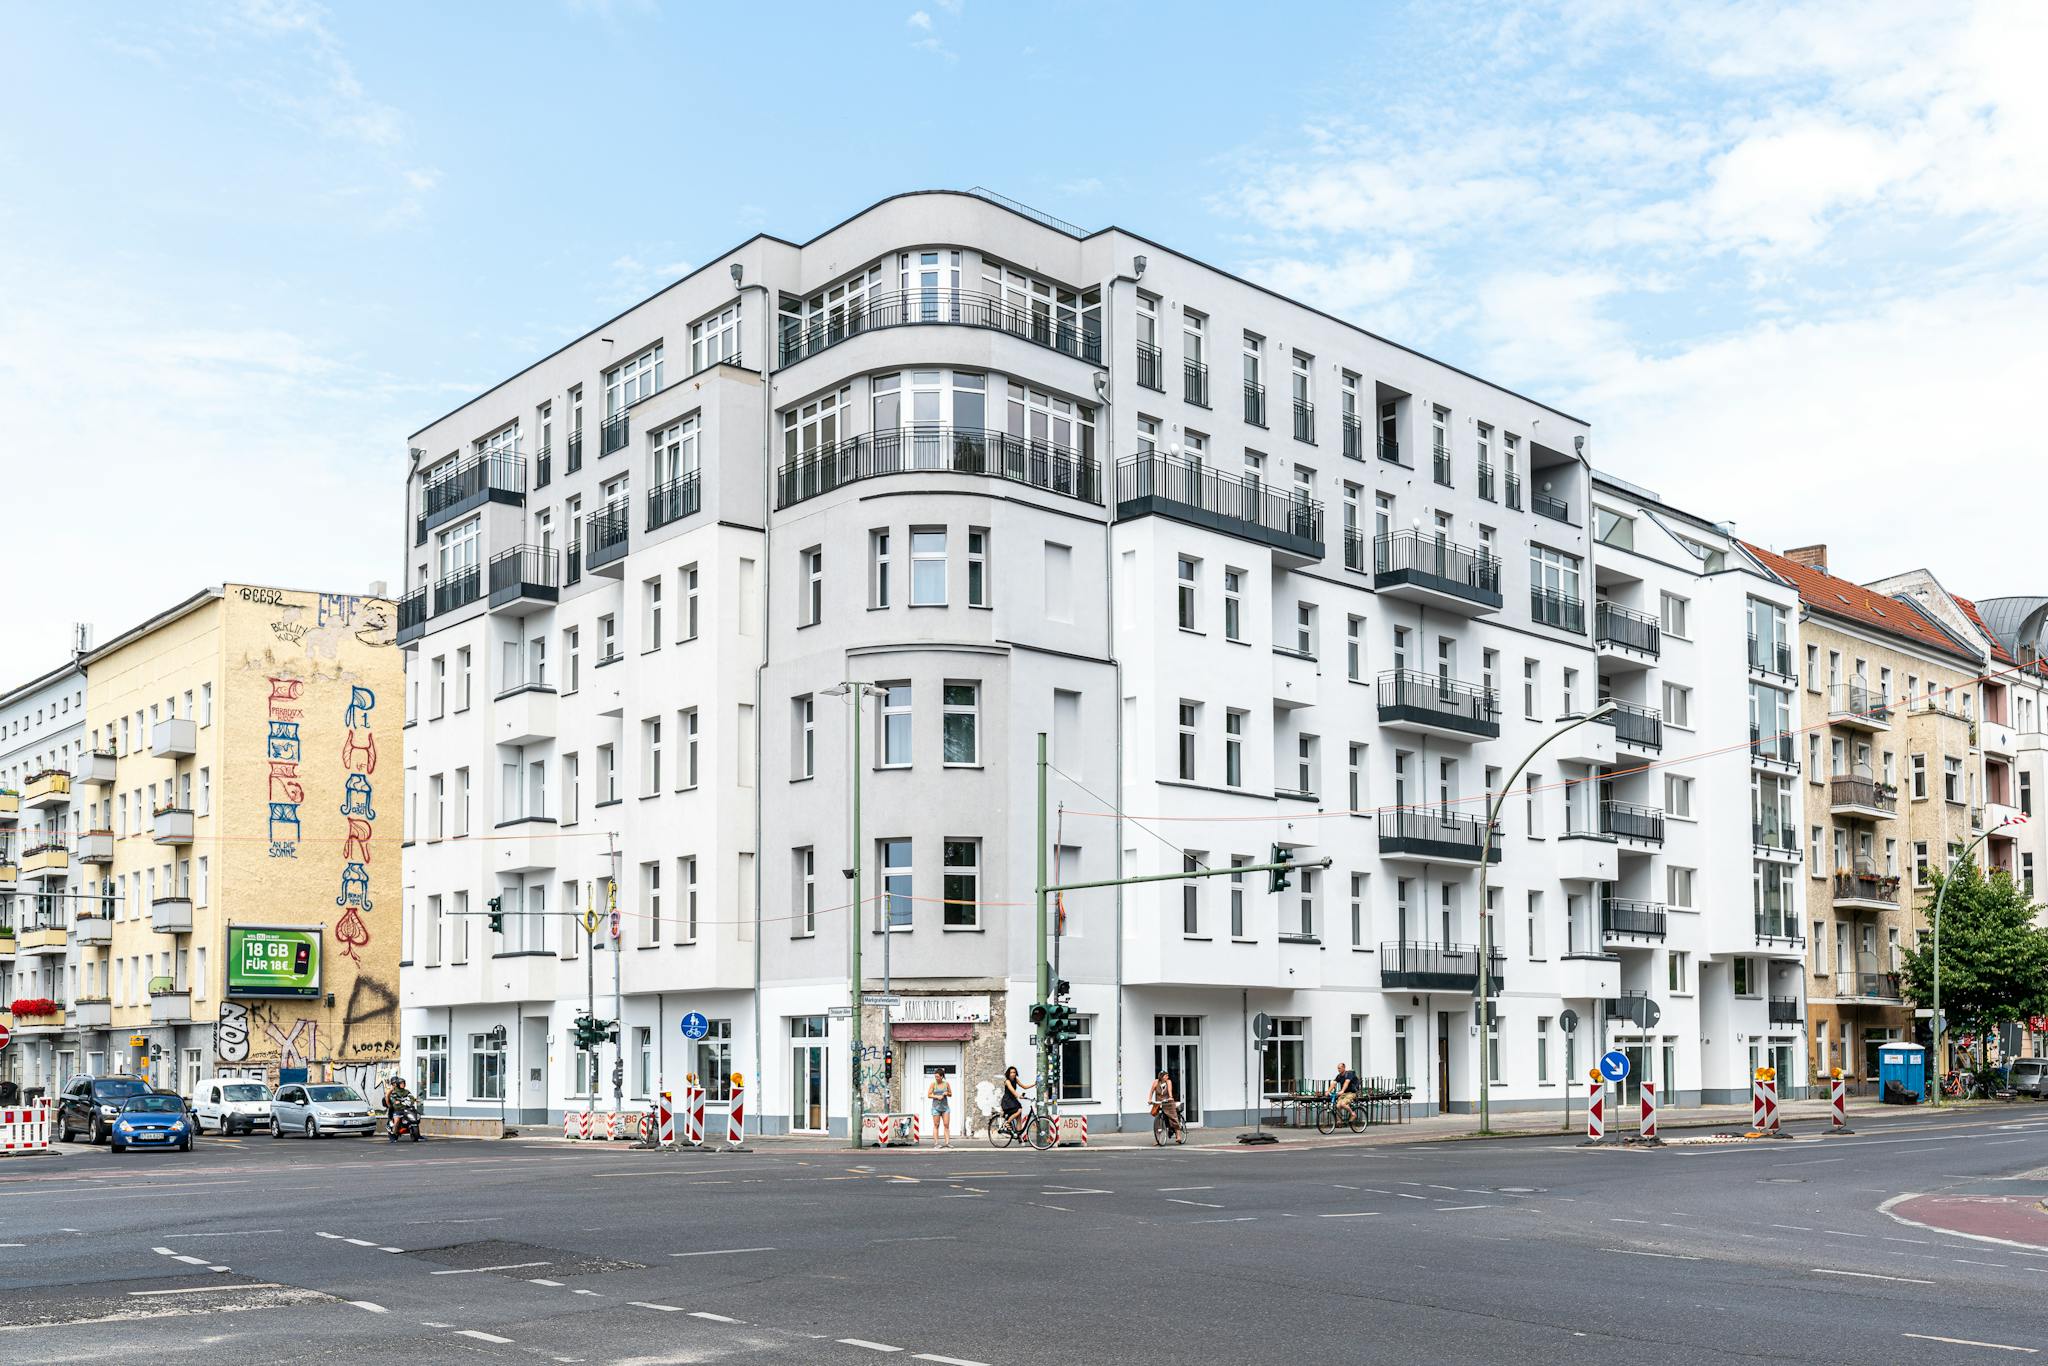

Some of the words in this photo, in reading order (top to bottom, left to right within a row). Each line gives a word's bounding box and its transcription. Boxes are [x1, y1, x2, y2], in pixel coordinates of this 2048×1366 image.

[268, 848, 298, 859] SONNE
[246, 942, 264, 957] 18
[267, 943, 289, 958] GB
[245, 957, 268, 970] FÜR
[1062, 1119, 1079, 1129] ABG
